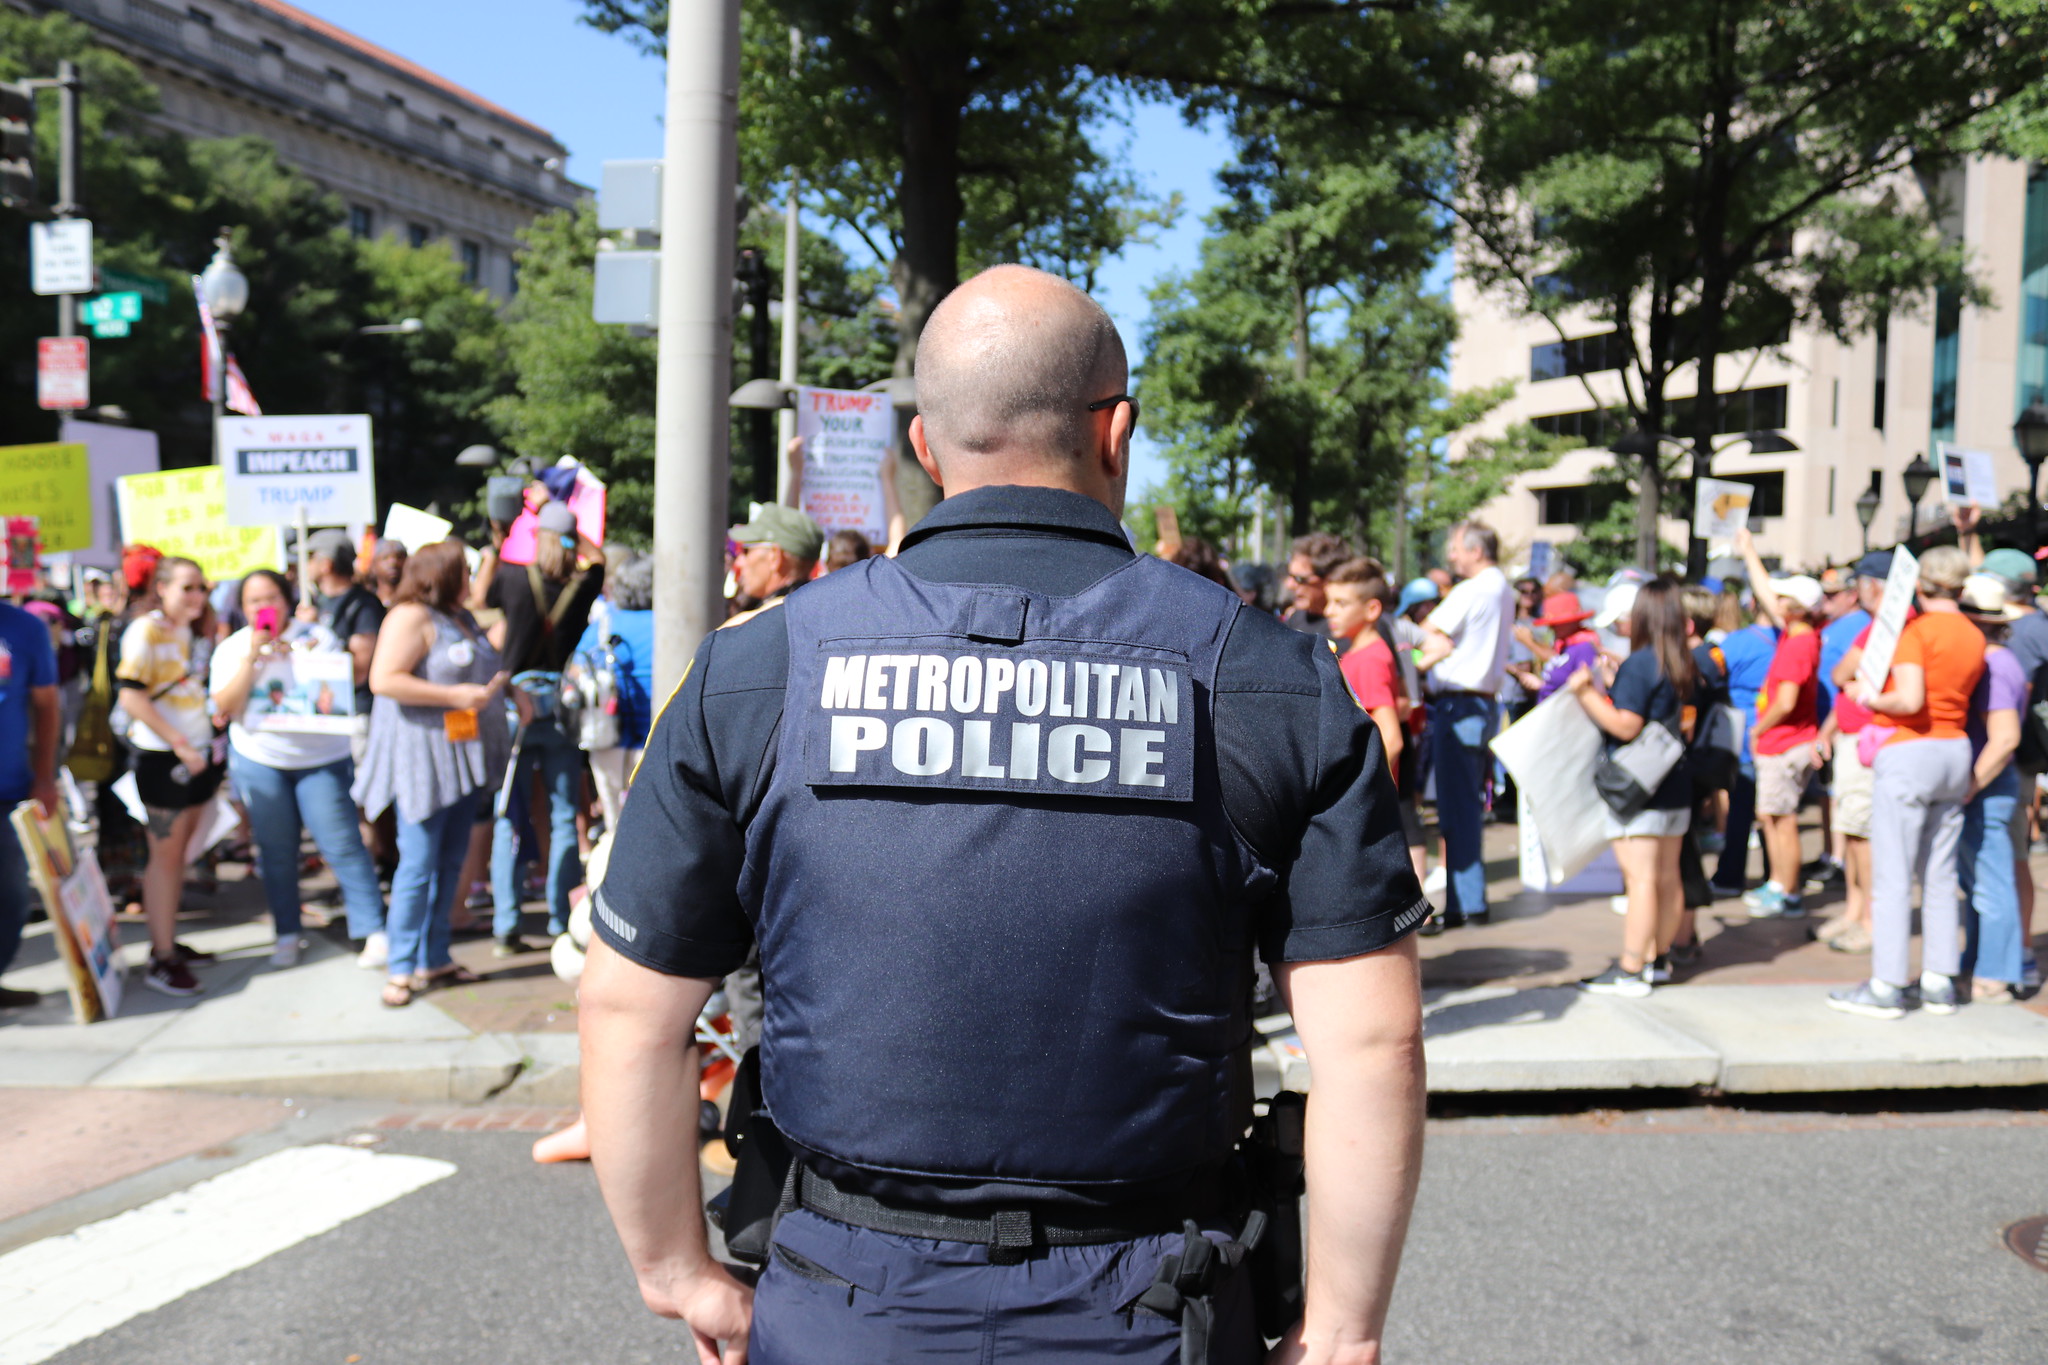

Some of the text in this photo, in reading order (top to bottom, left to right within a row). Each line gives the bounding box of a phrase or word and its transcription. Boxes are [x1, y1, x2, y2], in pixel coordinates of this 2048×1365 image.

[808, 391, 881, 413] TRUMP:
[820, 415, 864, 433] YOUR
[246, 449, 350, 474] IMPEACH
[258, 485, 335, 505] TRUMP
[820, 654, 1179, 724] METROPOLITAN
[829, 715, 1166, 788] POLICE
